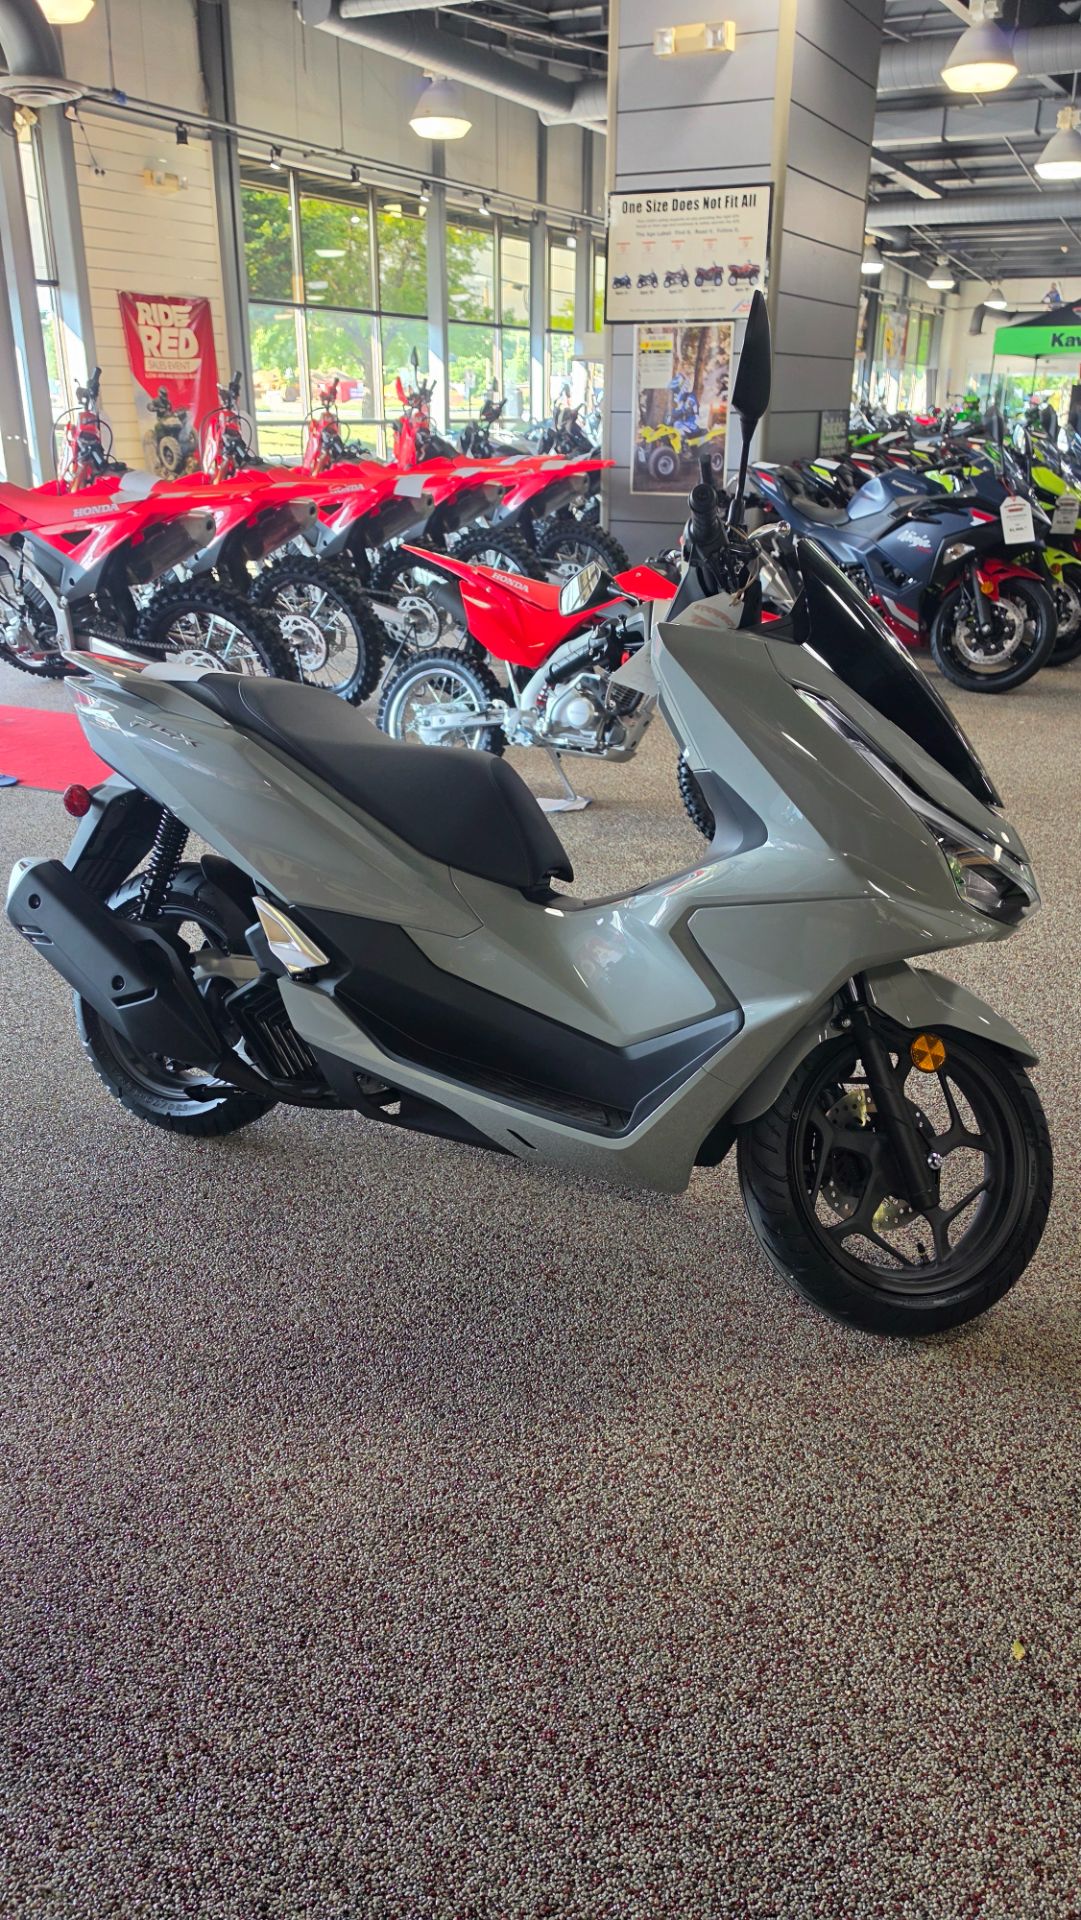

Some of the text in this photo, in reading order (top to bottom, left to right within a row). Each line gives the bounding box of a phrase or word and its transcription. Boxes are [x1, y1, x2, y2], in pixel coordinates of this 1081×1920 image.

[622, 194, 757, 214] One Size Does Not Fit All
[135, 301, 193, 328] RIDE
[138, 325, 199, 359] RED
[73, 503, 120, 518] HONDA
[491, 572, 529, 593] HONDA
